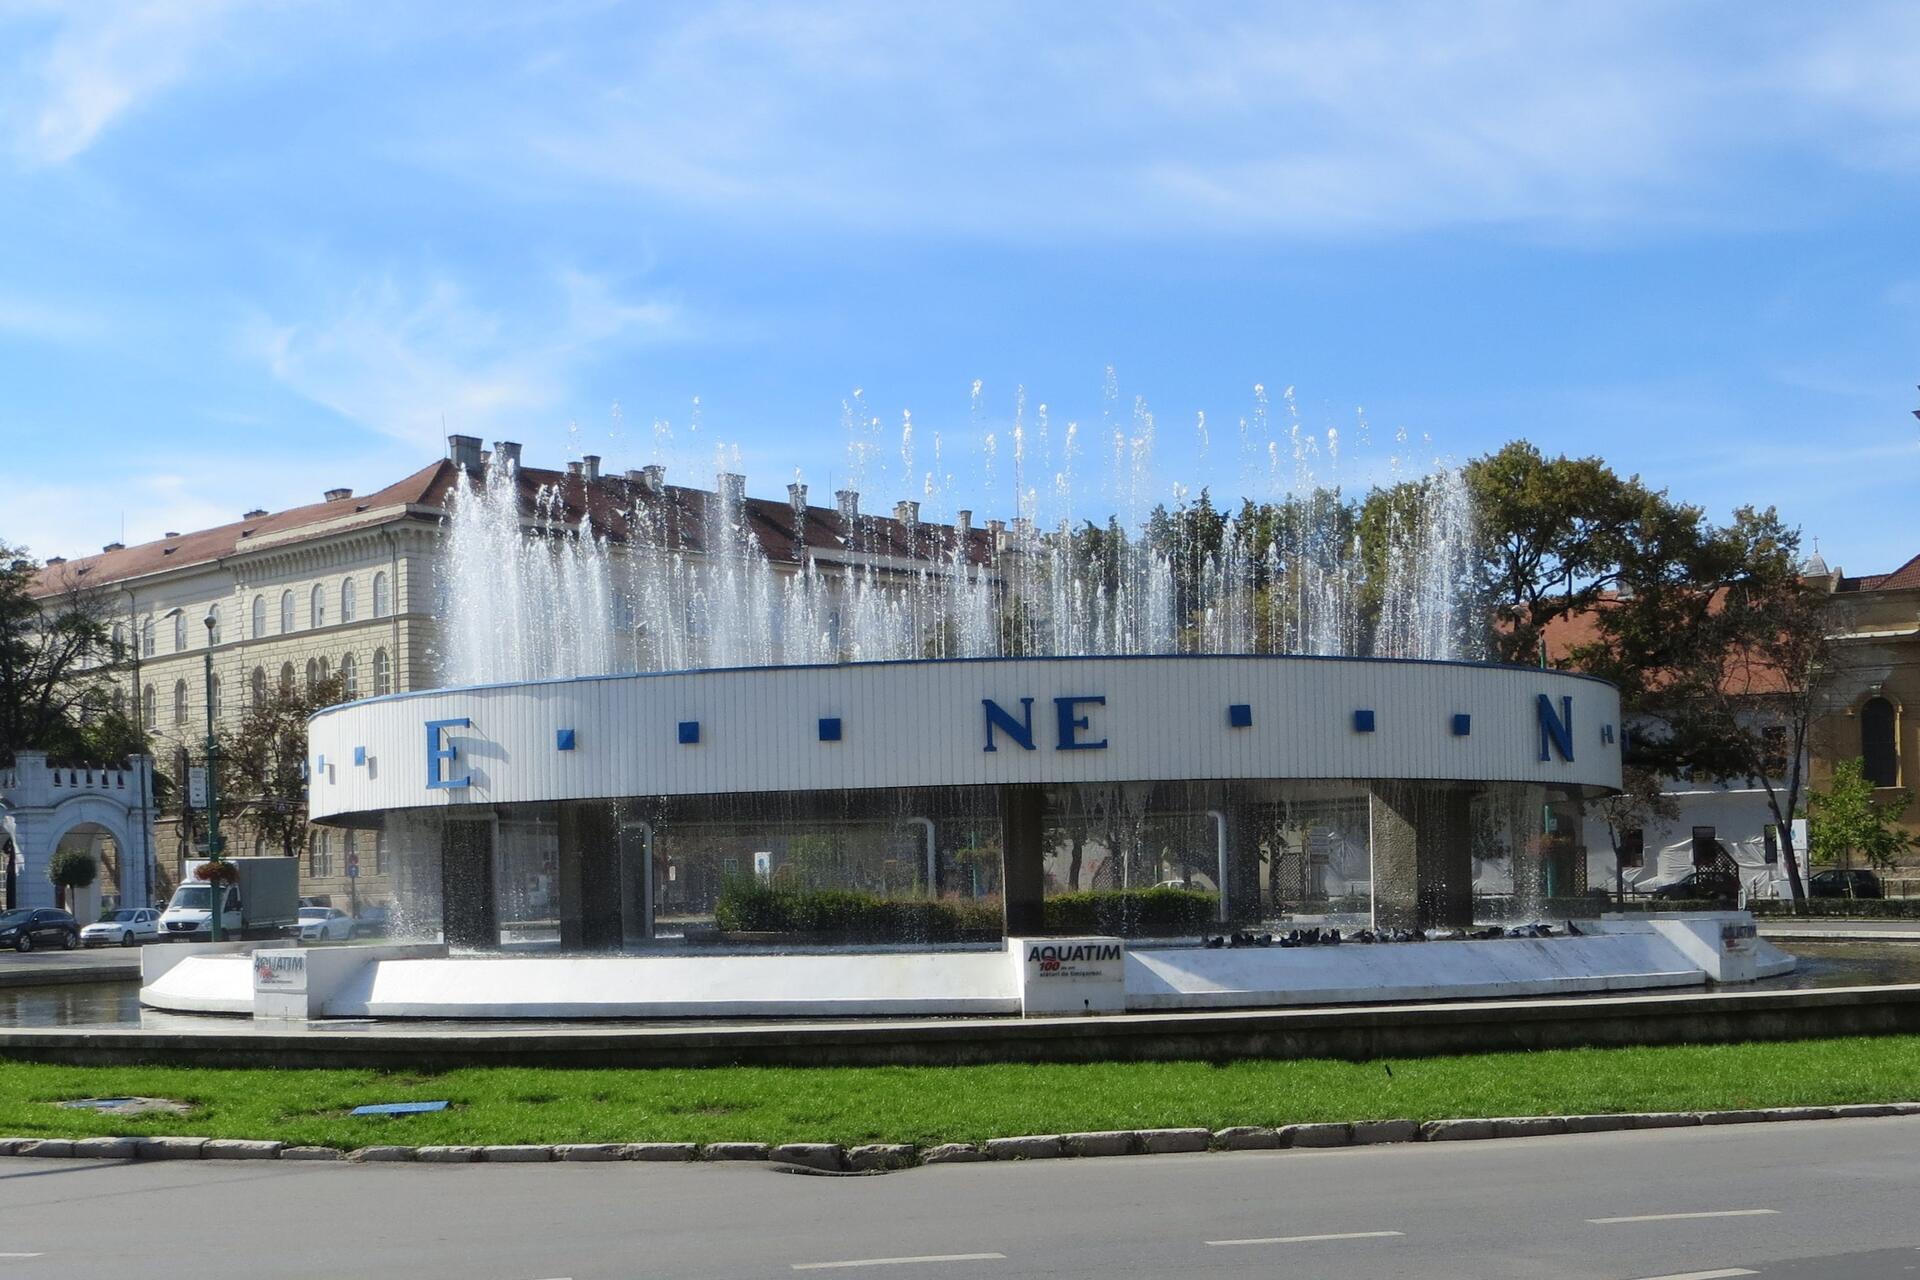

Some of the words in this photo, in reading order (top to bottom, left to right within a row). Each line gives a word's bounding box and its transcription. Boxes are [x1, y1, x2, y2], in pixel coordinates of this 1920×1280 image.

[1538, 693, 1575, 762] N
[424, 717, 471, 790] E
[1028, 944, 1121, 962] AQUATIM
[1040, 962, 1060, 971] 100
